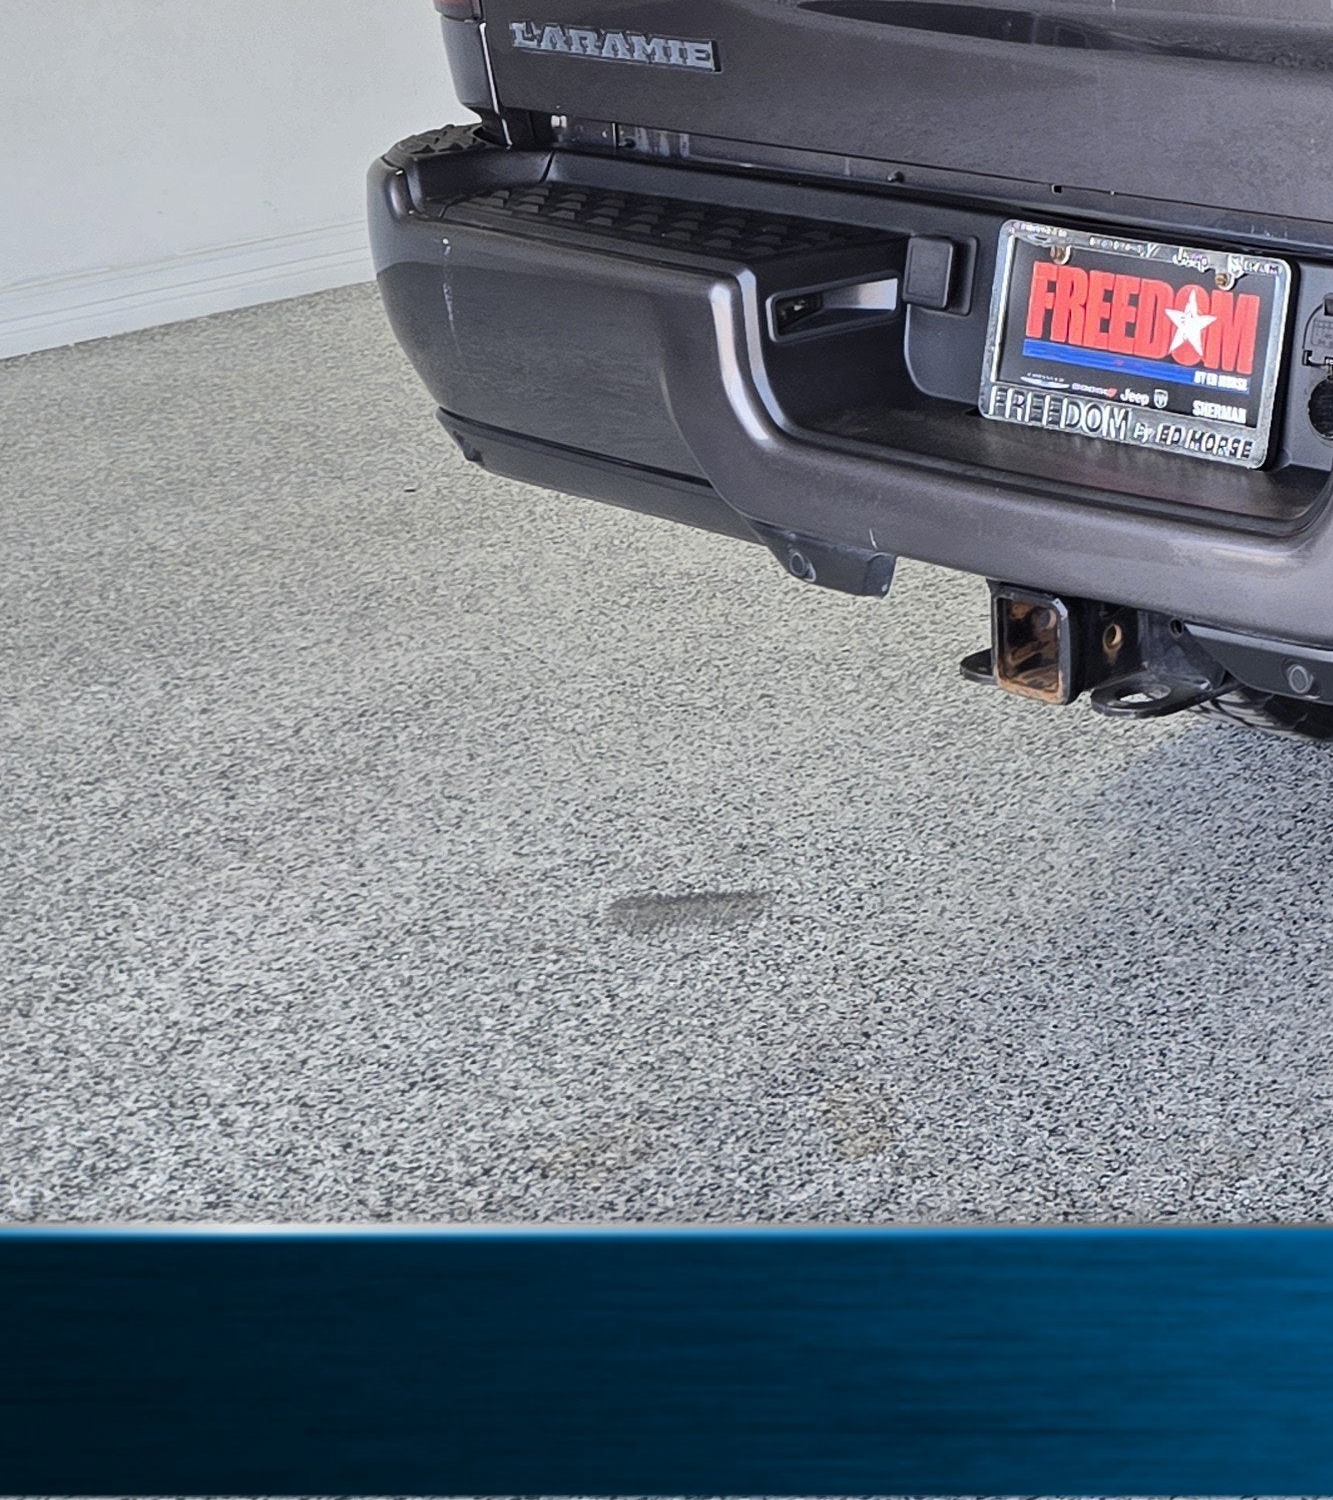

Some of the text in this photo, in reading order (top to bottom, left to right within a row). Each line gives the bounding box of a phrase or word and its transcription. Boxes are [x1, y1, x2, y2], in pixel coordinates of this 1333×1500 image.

[508, 19, 720, 73] LARAMIE
[1025, 260, 1261, 376] FREEDOM
[988, 385, 1132, 442] FREEDOM
[1184, 428, 1255, 460] MORSE
[1120, 387, 1150, 407] Jeep
[1192, 399, 1248, 425] SHERMAN
